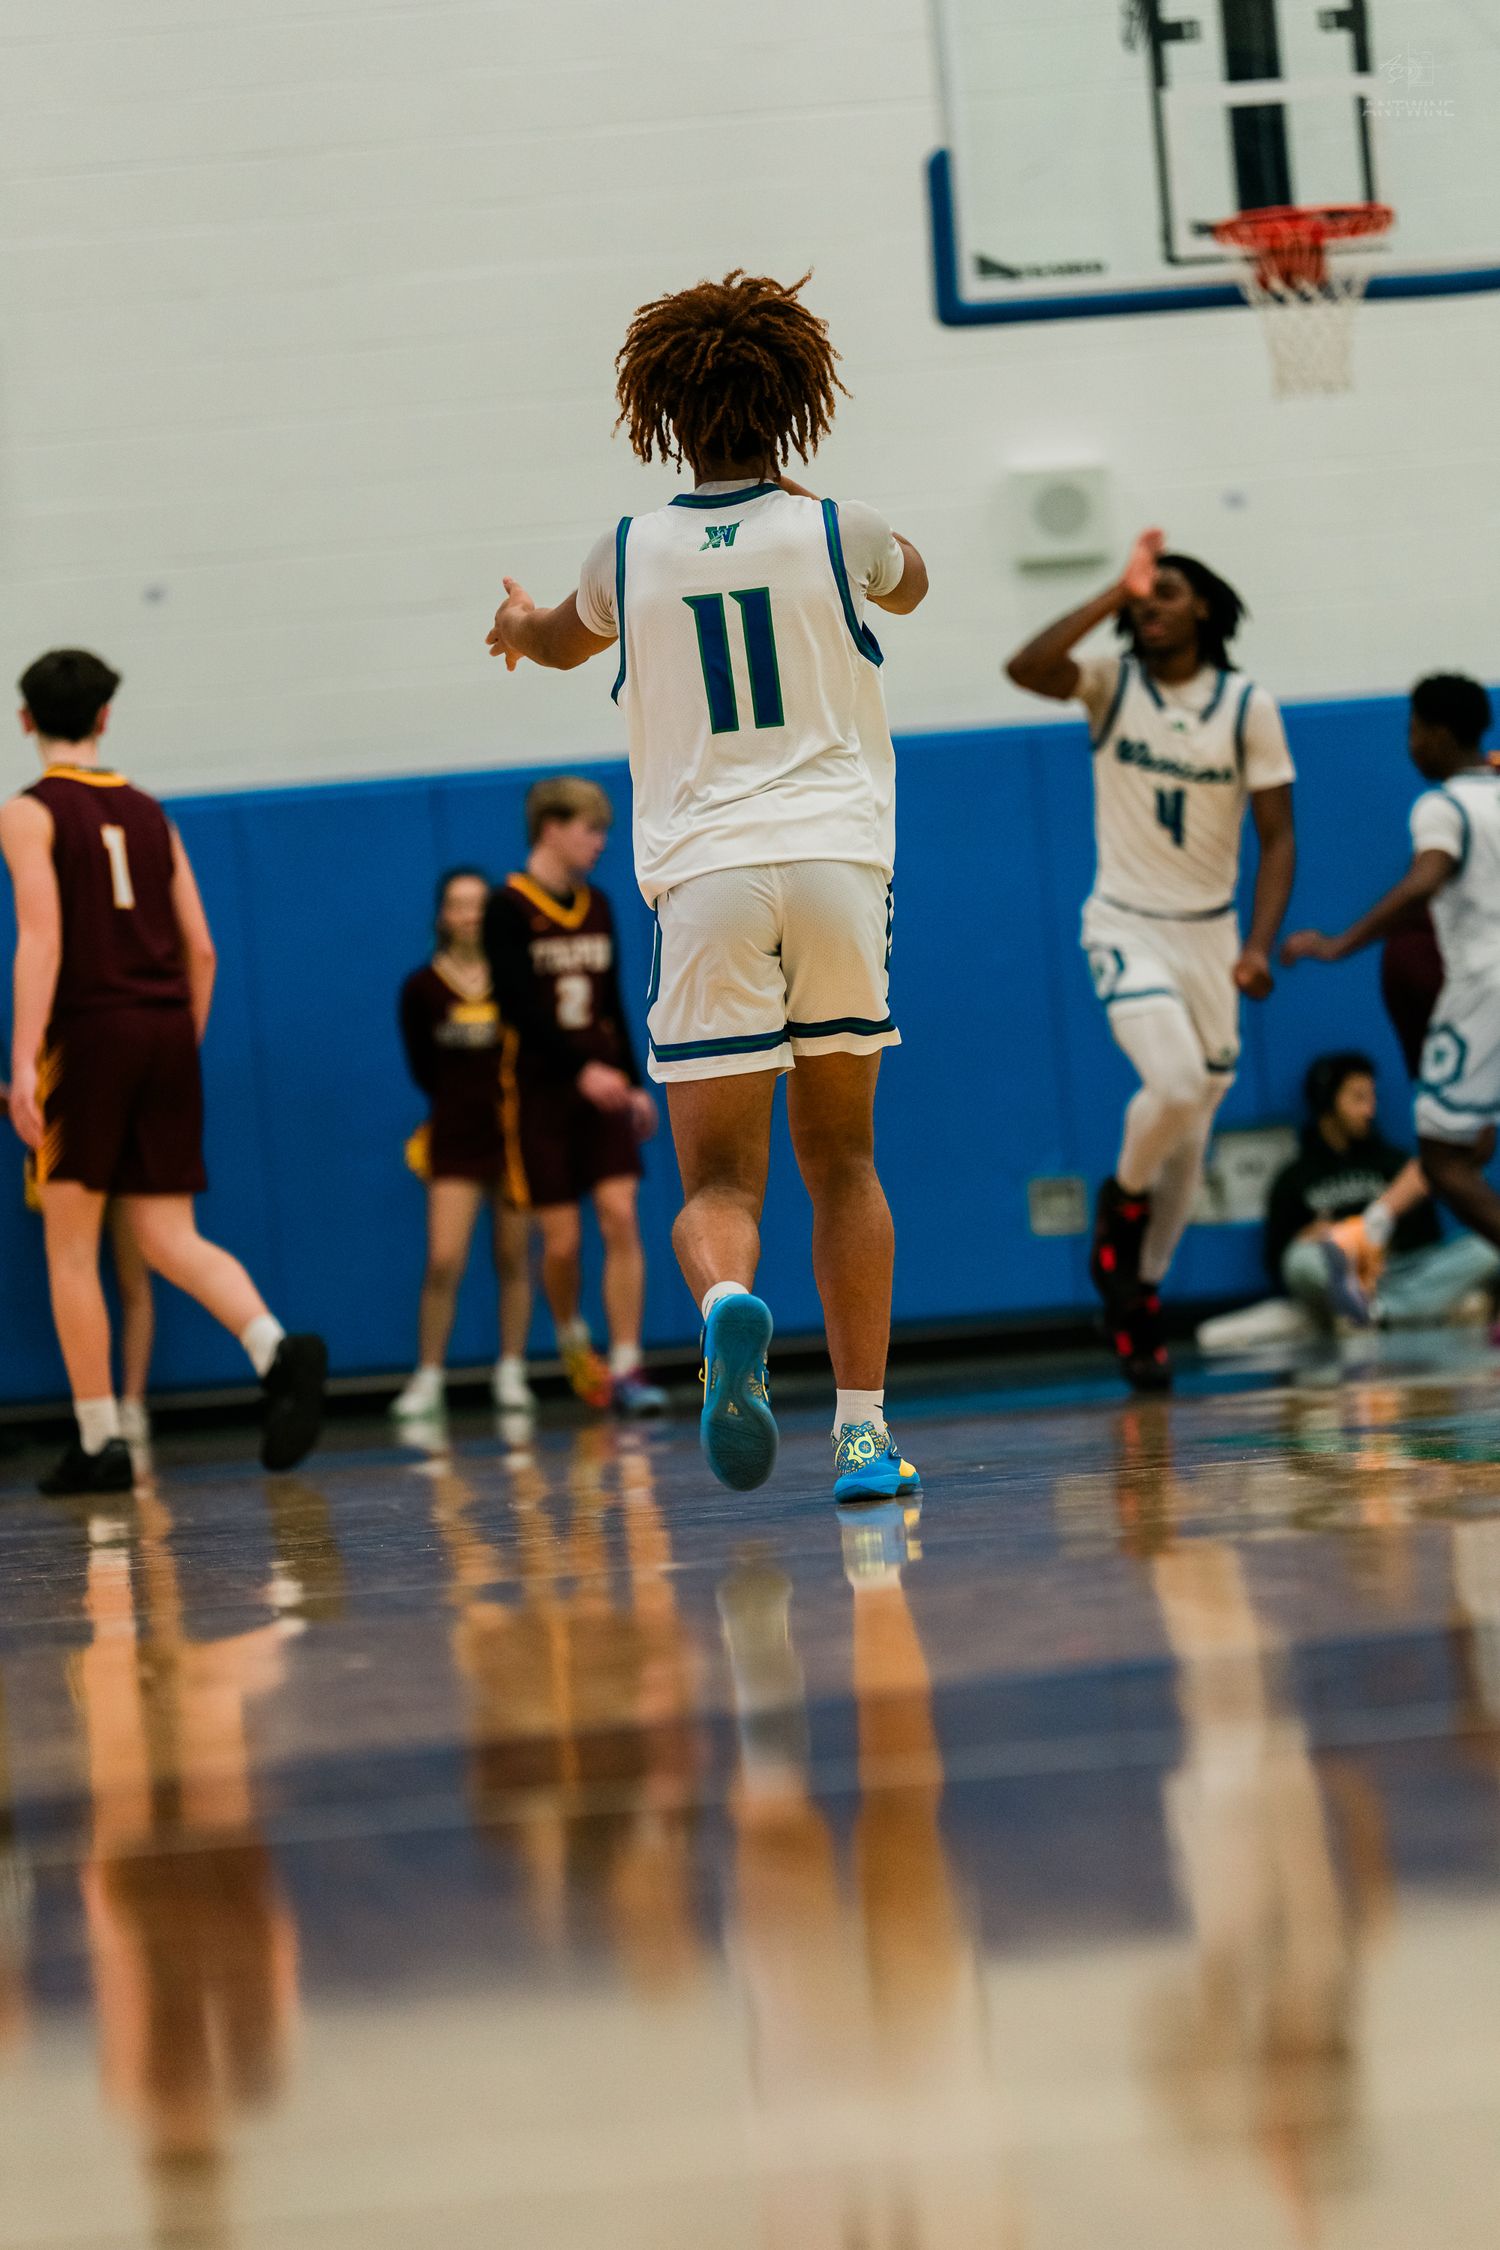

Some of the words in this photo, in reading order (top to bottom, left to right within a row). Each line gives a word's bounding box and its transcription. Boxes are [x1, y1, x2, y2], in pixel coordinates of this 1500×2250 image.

[681, 586, 786, 734] 11
[1155, 787, 1184, 847] 4
[100, 823, 136, 909] 1
